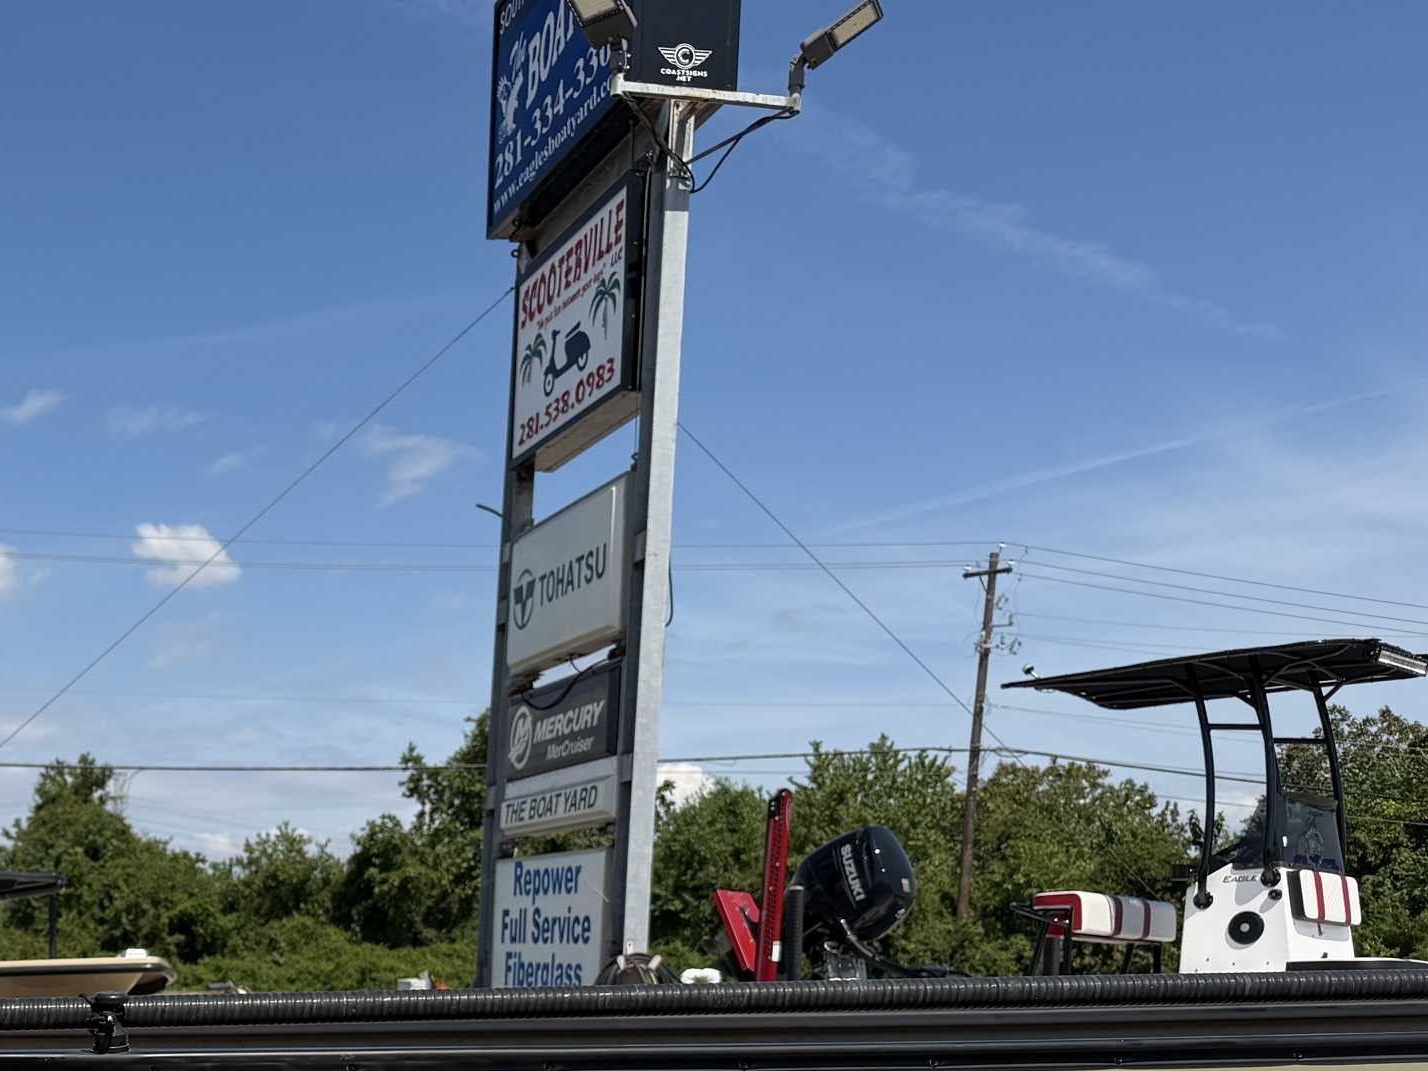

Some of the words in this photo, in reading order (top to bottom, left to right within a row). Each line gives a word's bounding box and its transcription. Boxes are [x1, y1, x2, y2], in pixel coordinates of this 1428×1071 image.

[520, 198, 624, 330] SCOOTERVILLE
[517, 357, 615, 446] 281.538.0983
[538, 542, 607, 608] TOHATSU
[533, 700, 605, 744] MERCURY
[546, 736, 594, 760] MerCruiser
[504, 801, 527, 825] THE
[528, 792, 562, 820] BOAT
[563, 785, 598, 815] YARD
[513, 861, 582, 905] Repower
[840, 843, 866, 902] SUZUKI
[501, 908, 527, 944] Full
[531, 906, 591, 944] Service
[504, 952, 583, 989] Fiberglass
